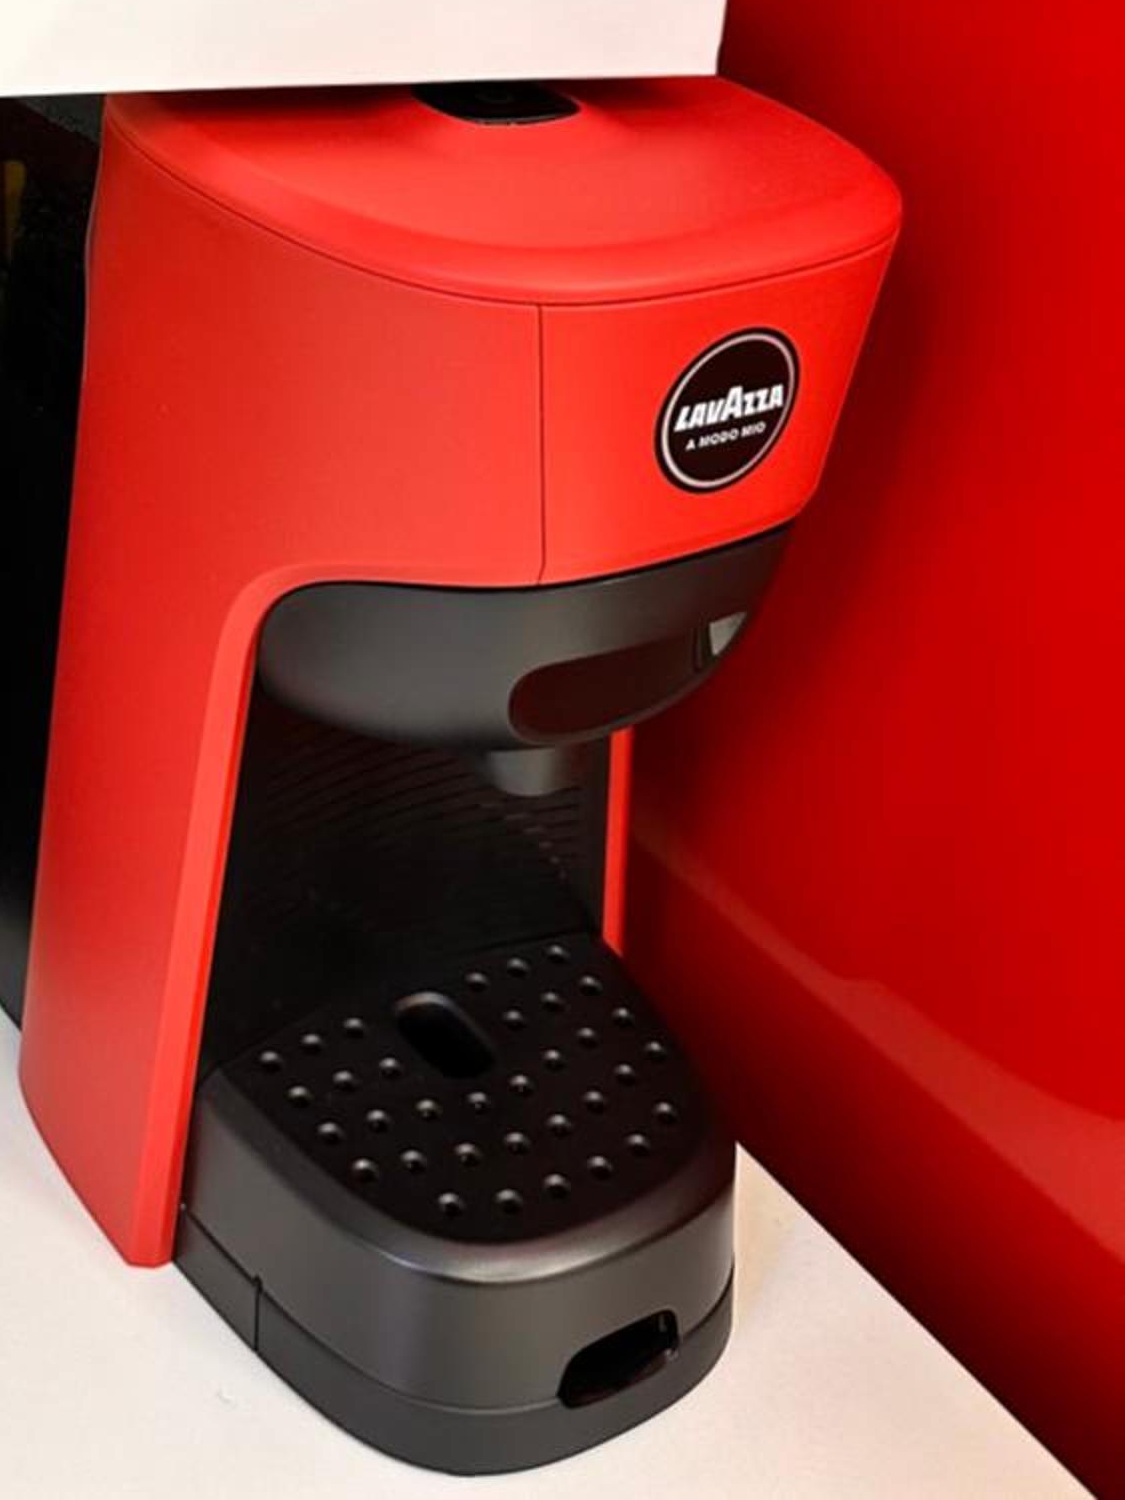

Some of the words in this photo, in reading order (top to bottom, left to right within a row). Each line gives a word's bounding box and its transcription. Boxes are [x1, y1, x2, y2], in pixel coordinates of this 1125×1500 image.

[673, 383, 785, 433] LAVAZZA
[685, 438, 696, 451] A
[698, 428, 741, 449] MODO
[740, 420, 767, 439] MIO
